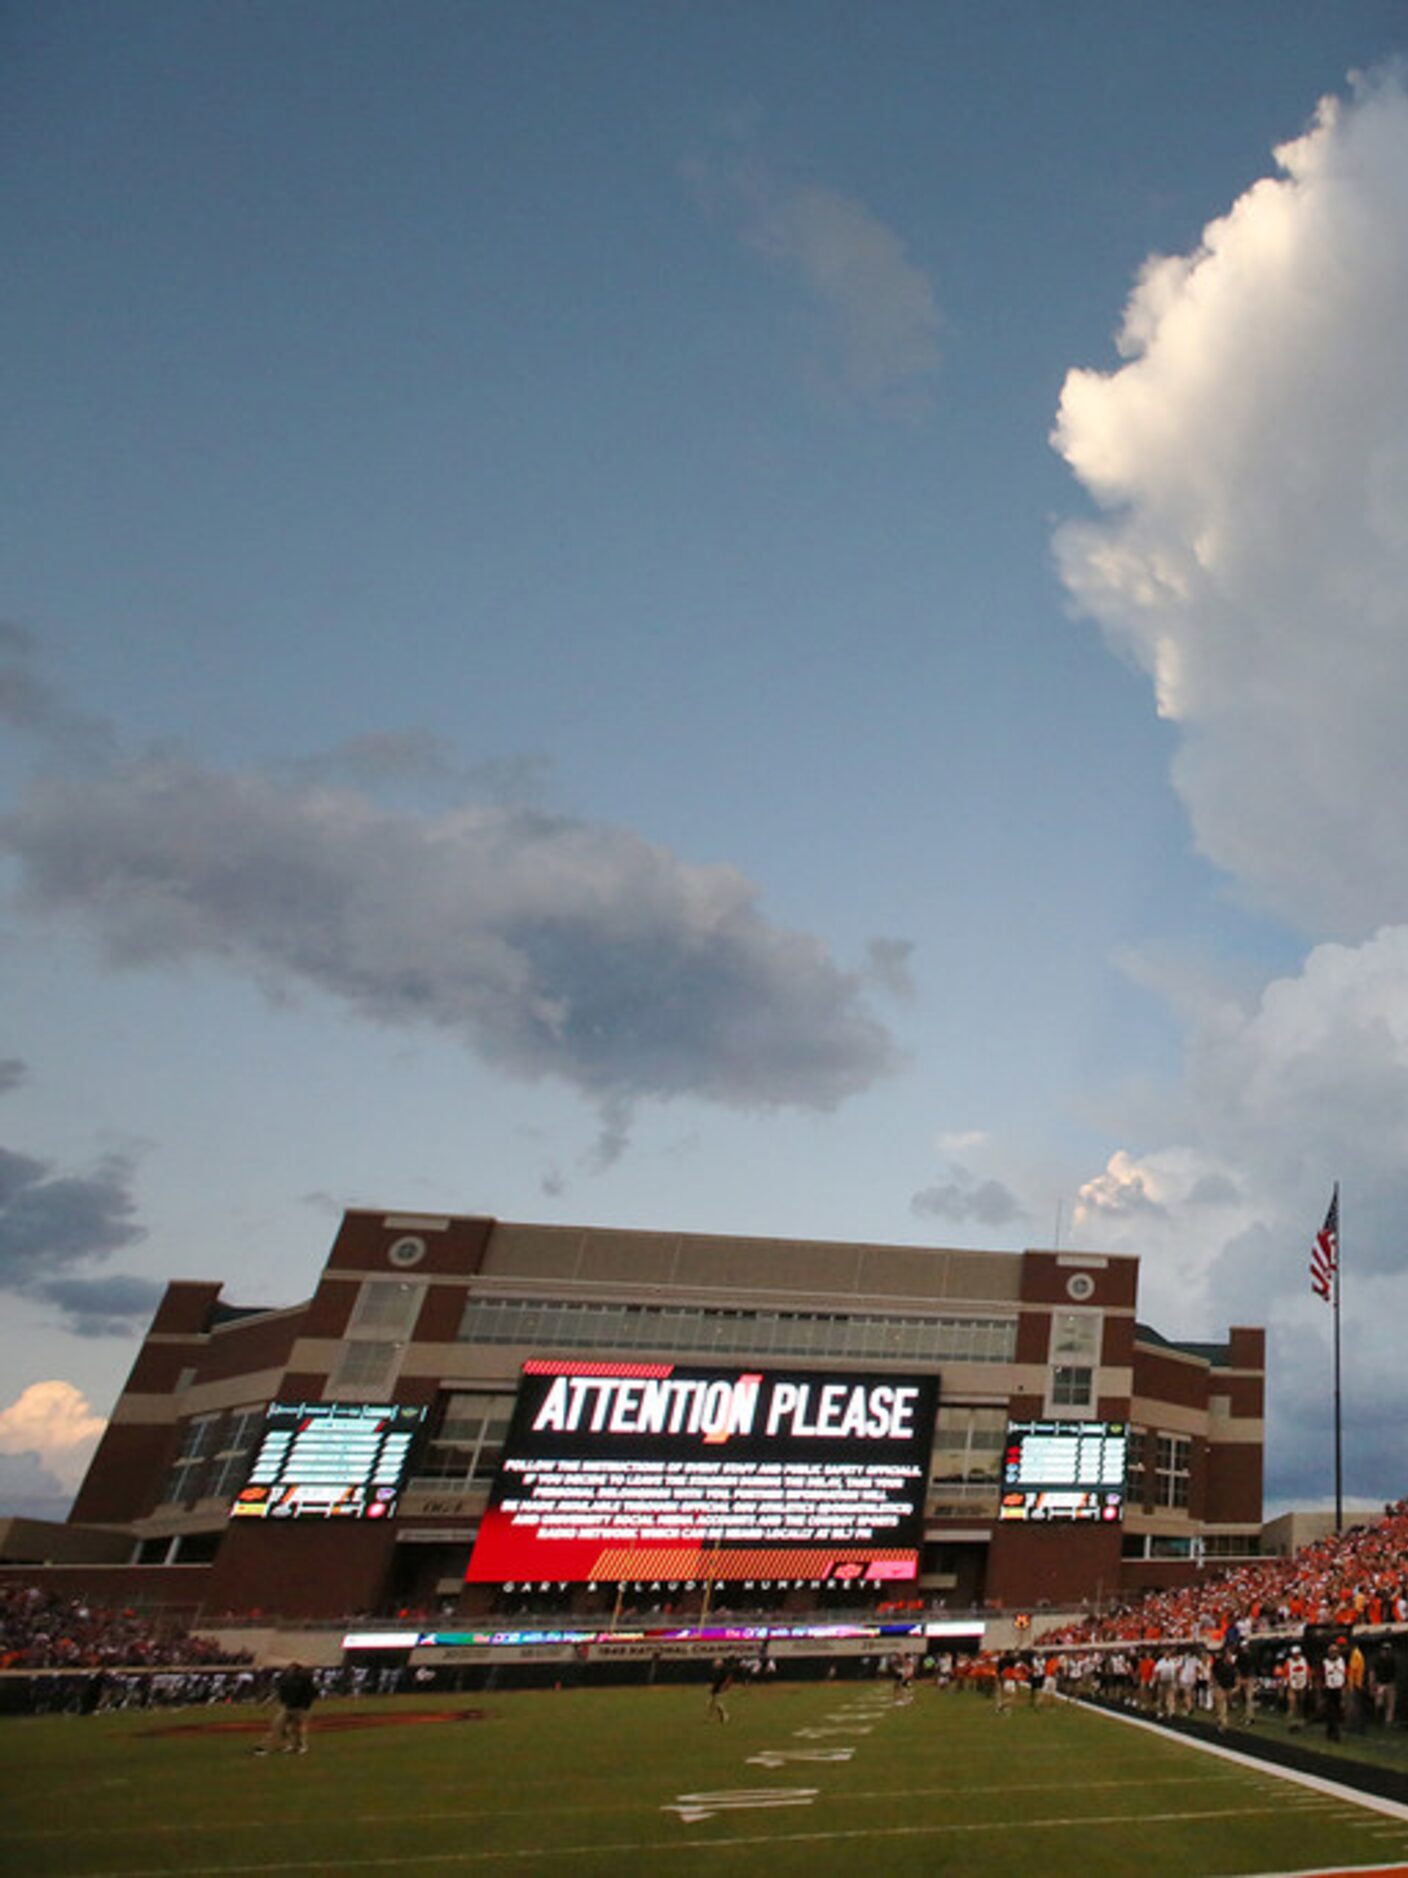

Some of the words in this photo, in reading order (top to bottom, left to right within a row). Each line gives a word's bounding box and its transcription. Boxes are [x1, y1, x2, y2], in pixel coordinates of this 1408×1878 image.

[531, 1376, 760, 1435] ATTENTION
[765, 1383, 920, 1439] PLEASE
[502, 1581, 568, 1593] GARY
[617, 1580, 726, 1592] CLAUDIA
[744, 1580, 882, 1591] HUMPHREYS
